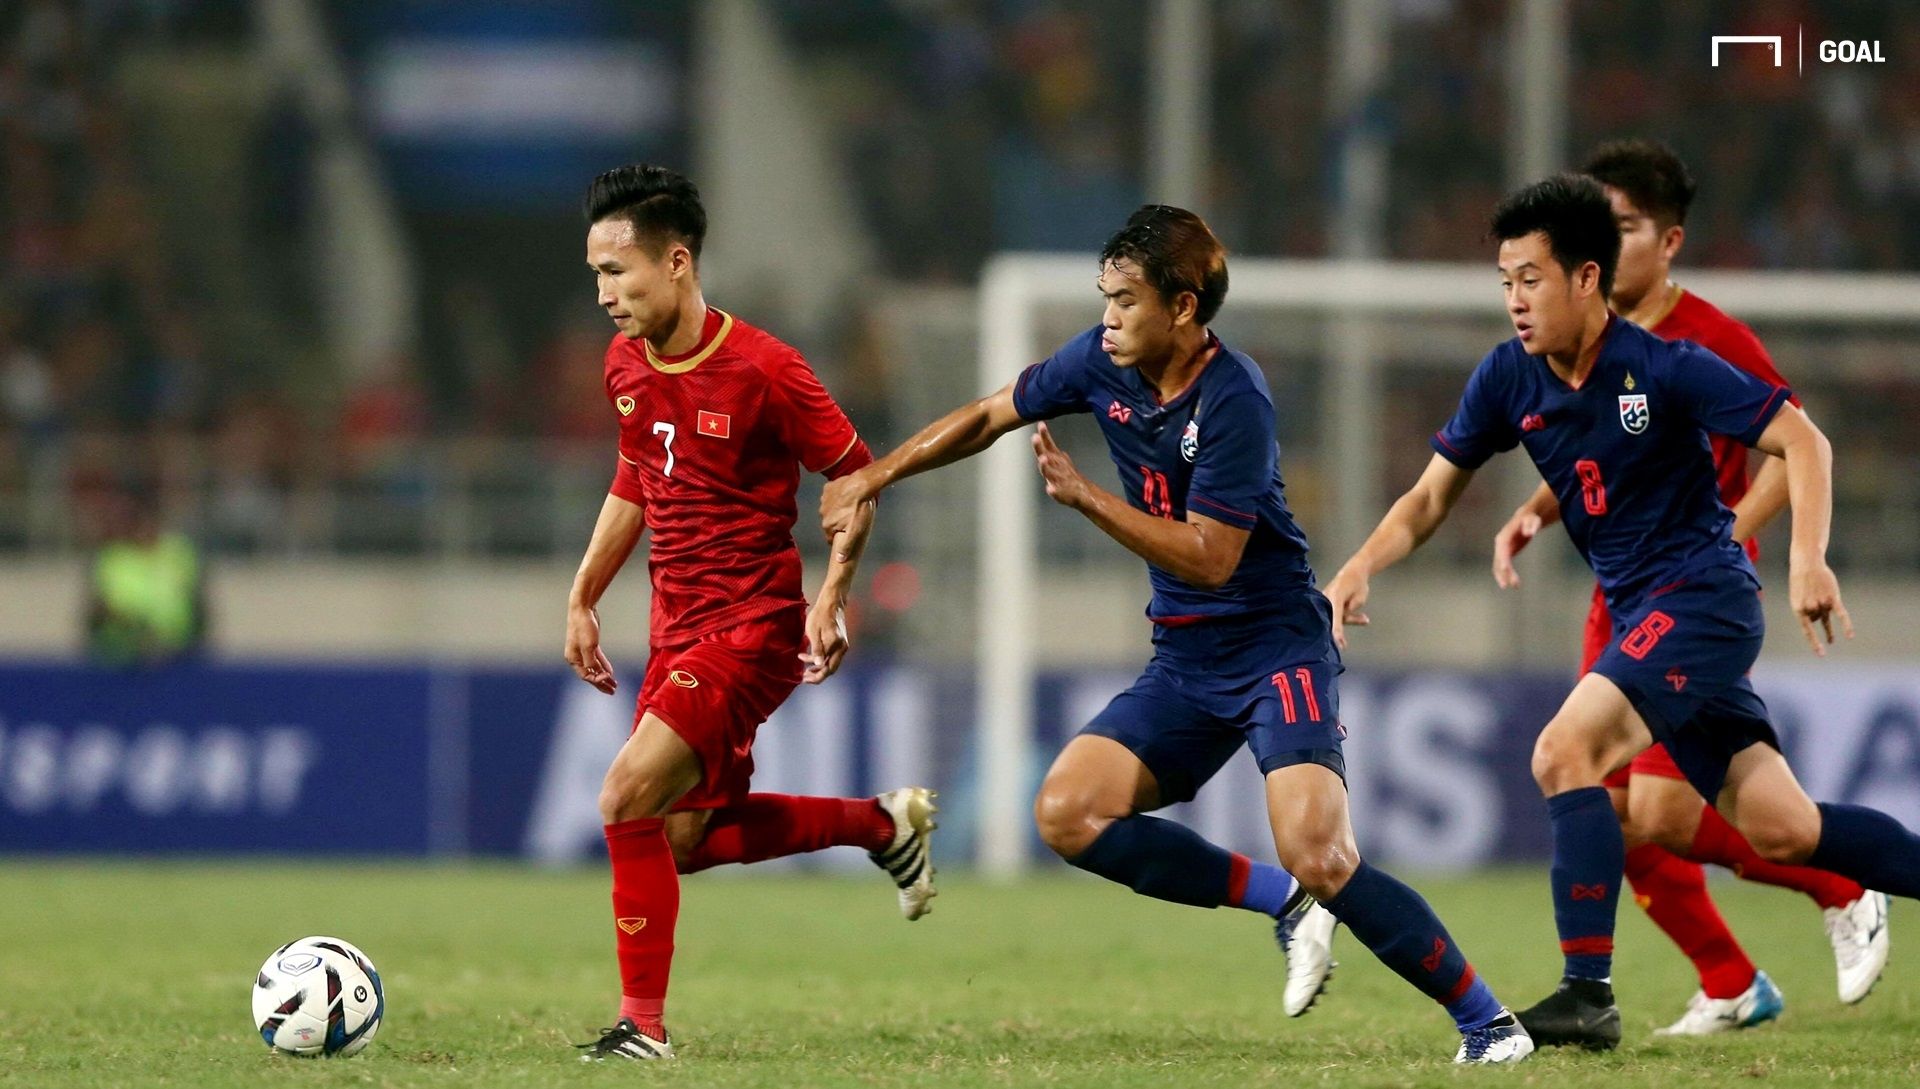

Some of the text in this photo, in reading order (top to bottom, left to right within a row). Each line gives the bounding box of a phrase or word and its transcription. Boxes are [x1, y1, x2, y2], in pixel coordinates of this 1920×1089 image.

[652, 421, 675, 478] 7
[1139, 465, 1175, 521] 11
[1574, 459, 1608, 516] 8
[1620, 610, 1675, 660] 8
[1271, 668, 1320, 724] 11
